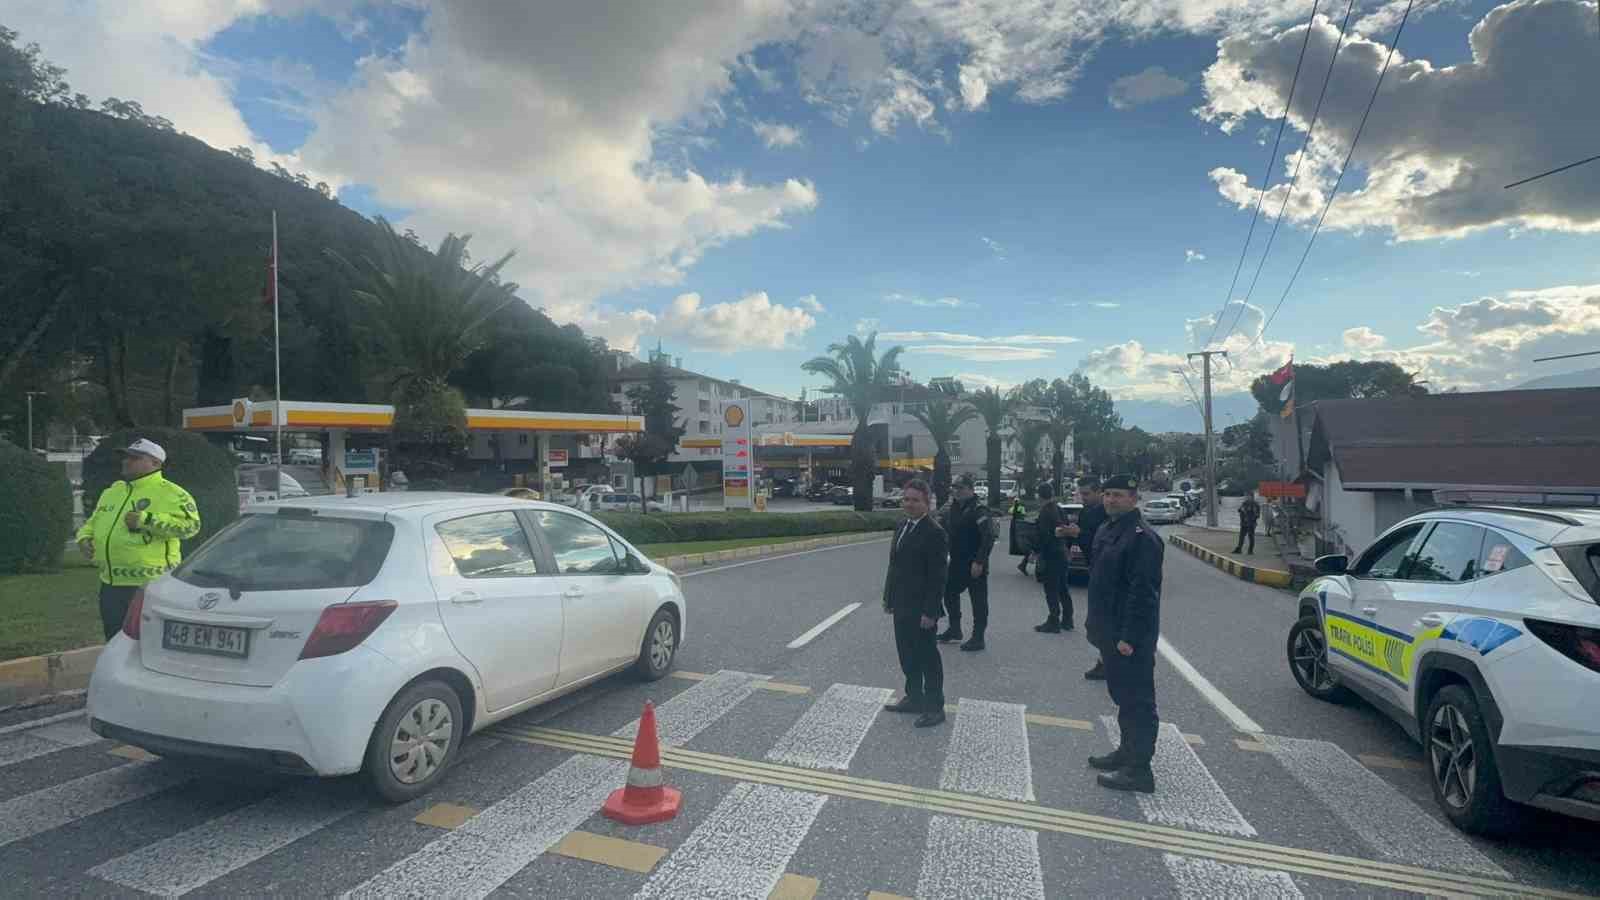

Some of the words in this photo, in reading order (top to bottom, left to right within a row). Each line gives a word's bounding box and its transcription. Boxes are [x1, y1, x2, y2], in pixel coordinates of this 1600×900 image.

[169, 624, 189, 643] 48
[194, 627, 211, 650] EN
[217, 629, 242, 652] 941
